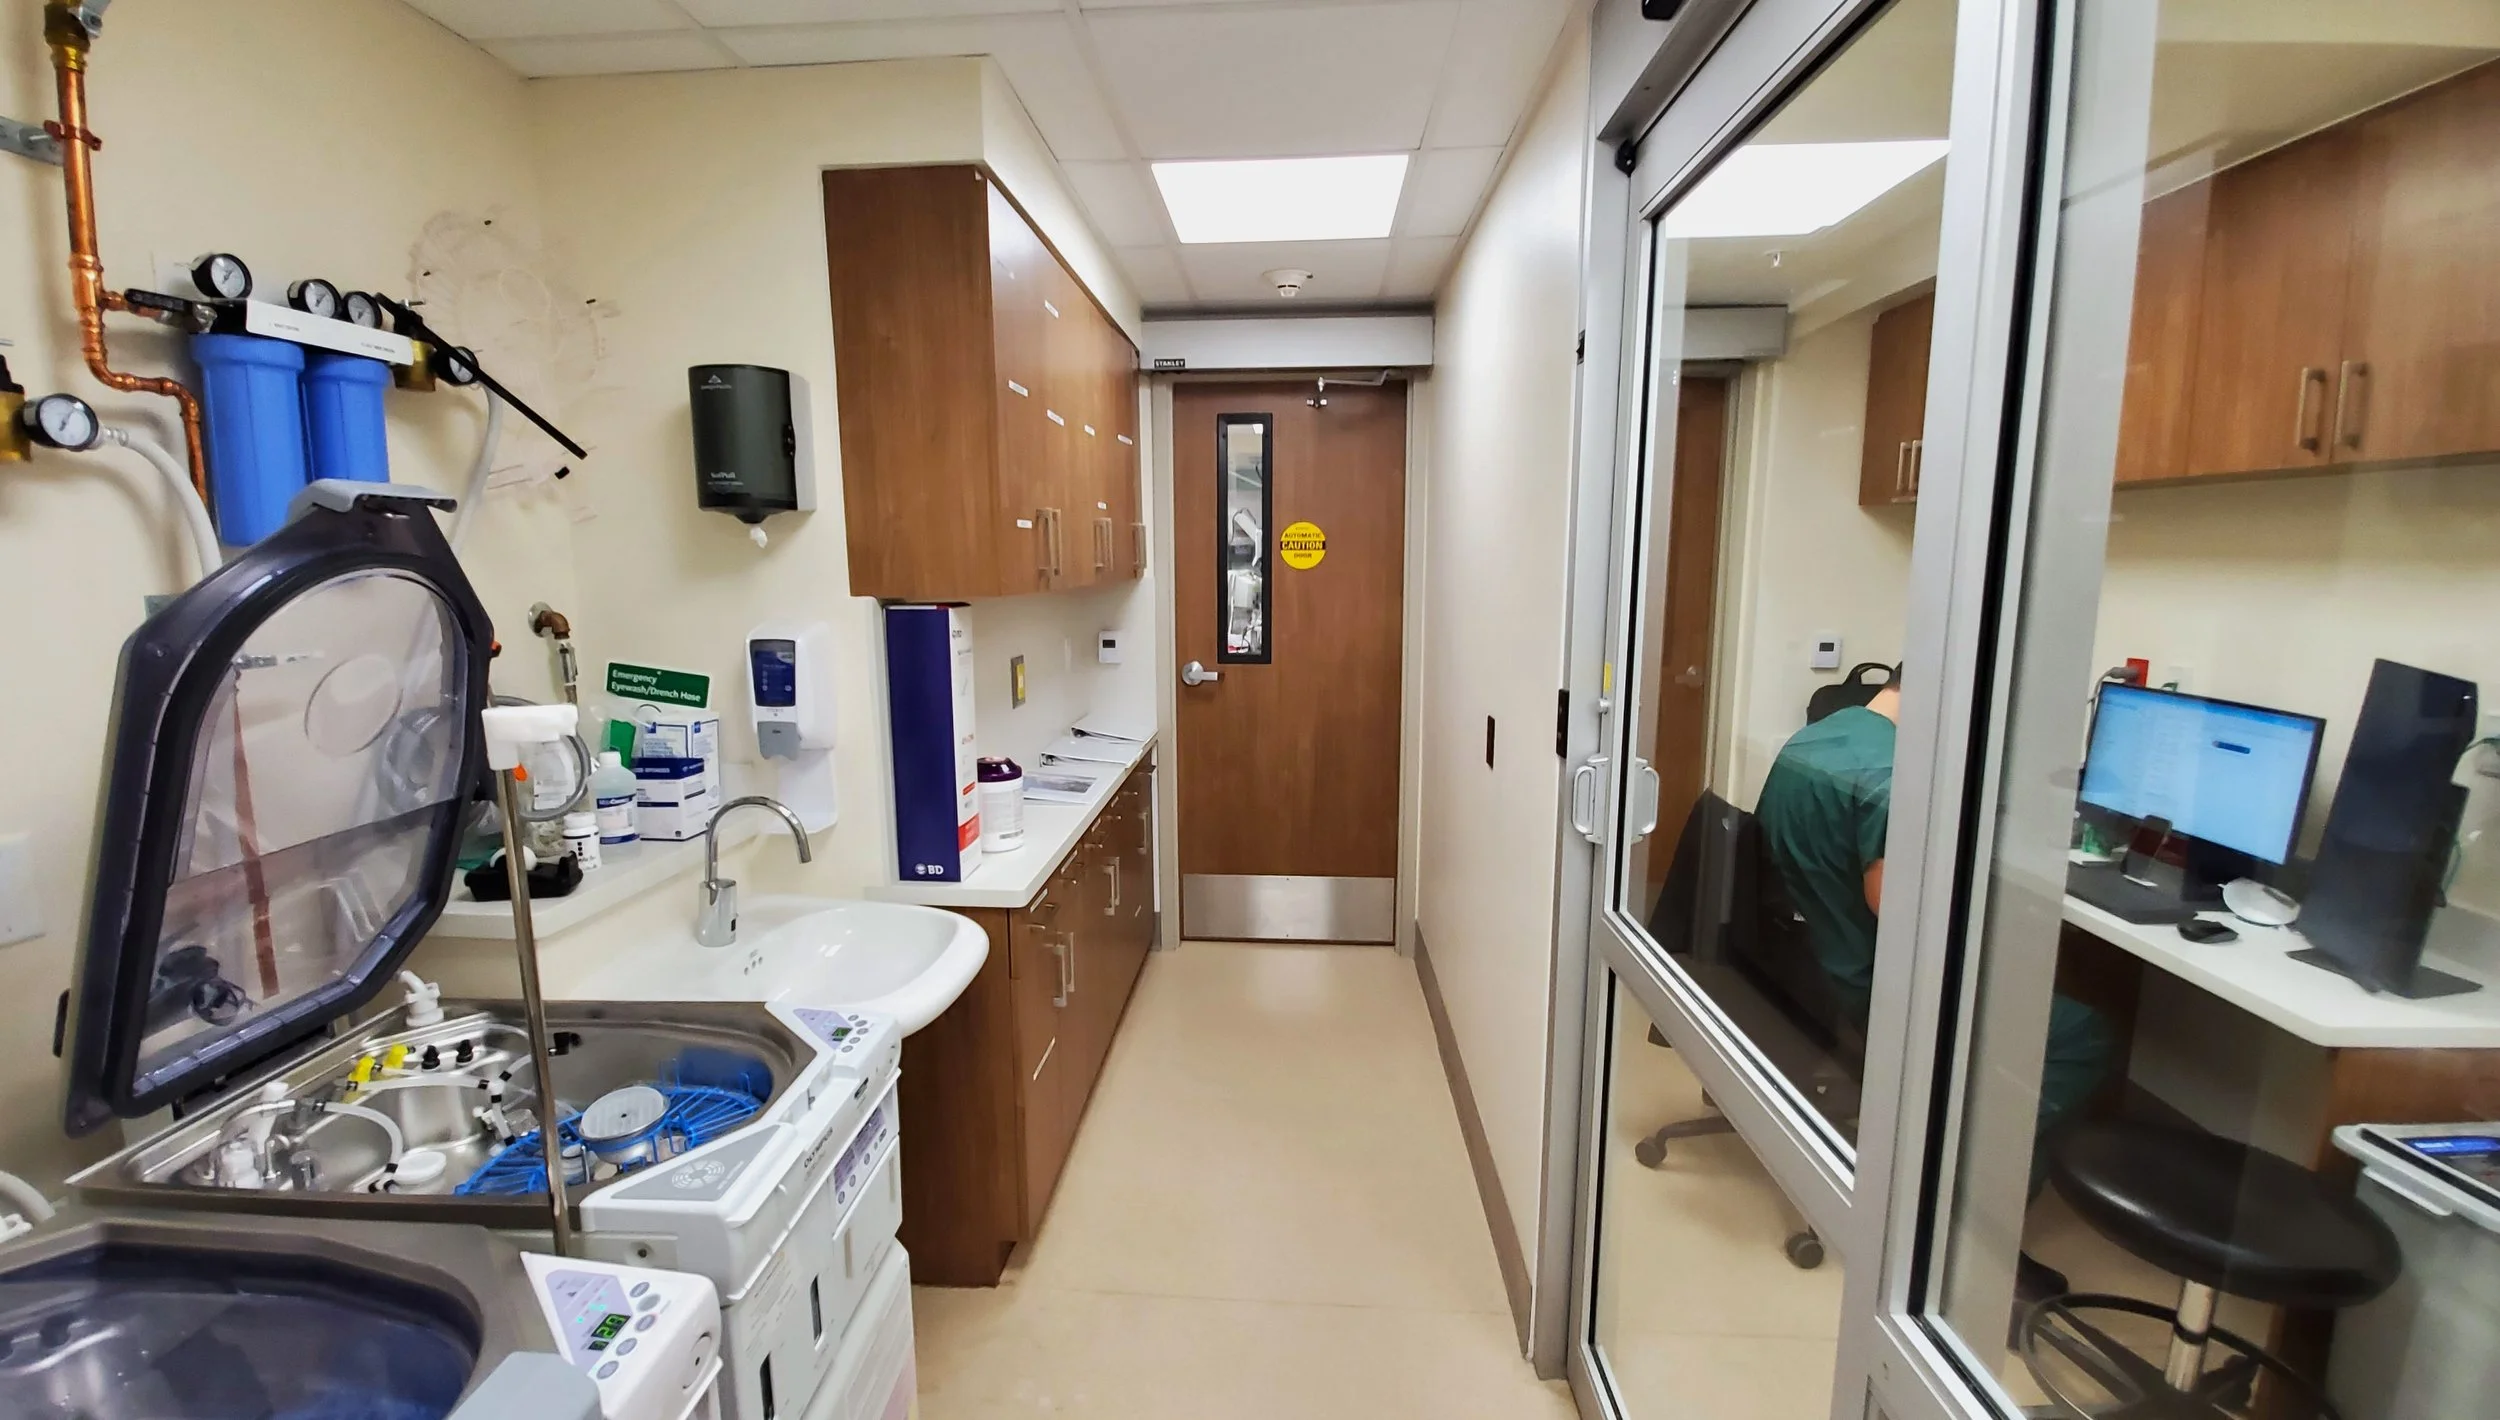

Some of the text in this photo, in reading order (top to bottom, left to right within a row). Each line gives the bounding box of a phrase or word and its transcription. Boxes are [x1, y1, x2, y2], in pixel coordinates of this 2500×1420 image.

[1282, 541, 1323, 550] CAUTION
[612, 669, 657, 685] Emergency
[611, 681, 701, 702] Eyewash/Drench Hose
[927, 864, 944, 875] BD
